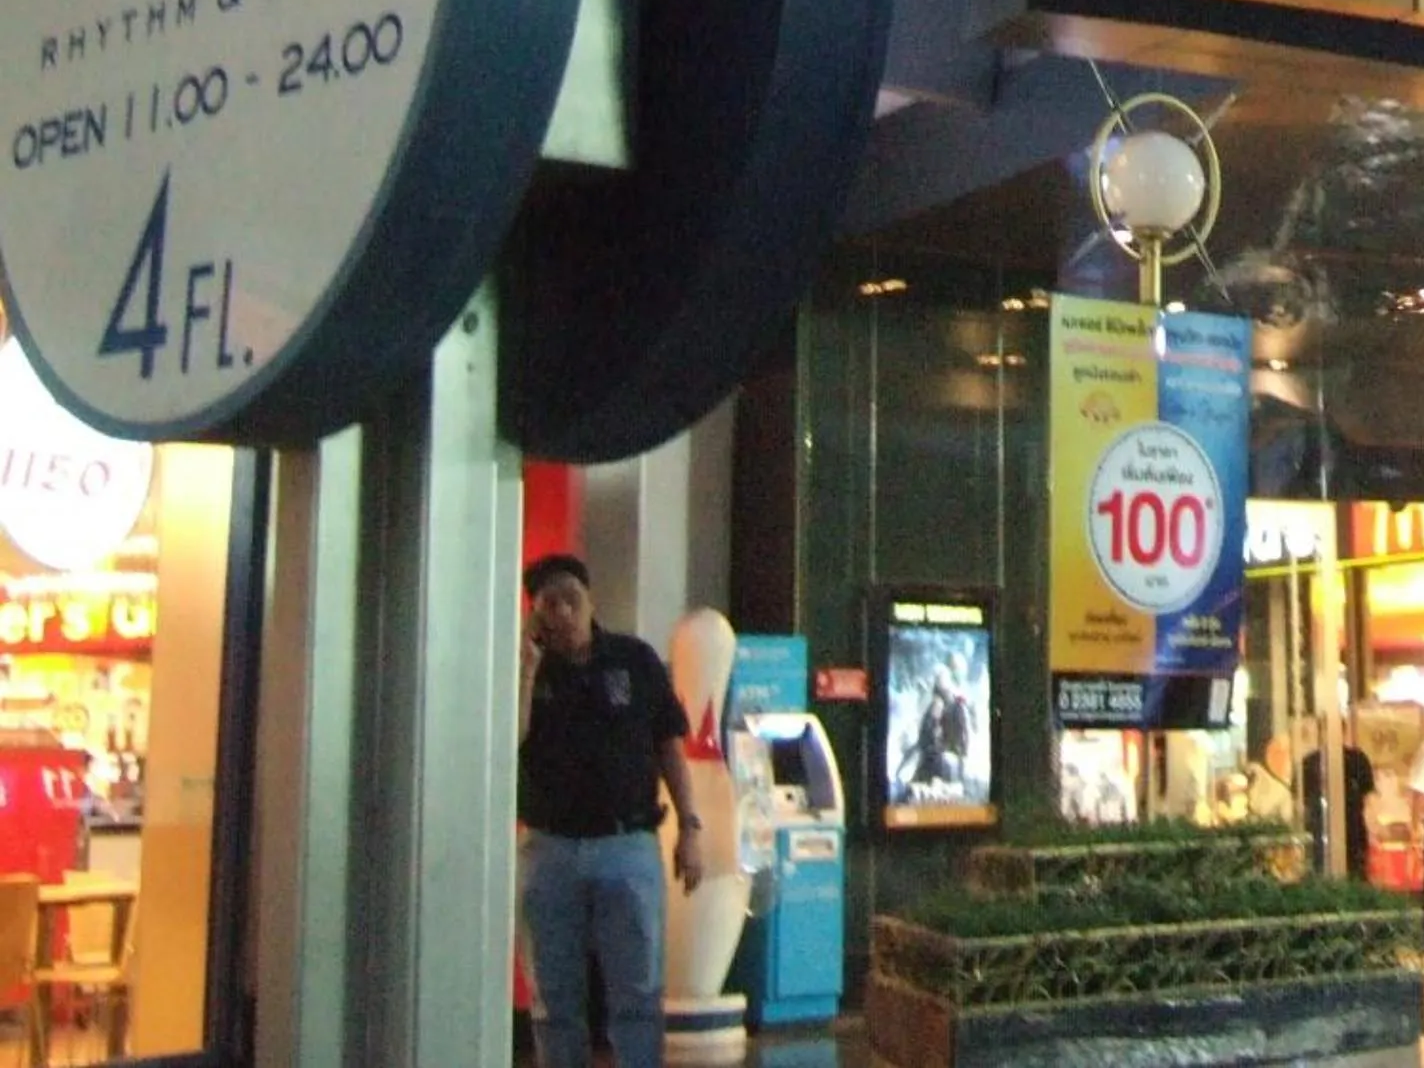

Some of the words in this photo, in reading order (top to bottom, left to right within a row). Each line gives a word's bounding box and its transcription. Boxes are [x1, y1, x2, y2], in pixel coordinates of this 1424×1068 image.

[12, 102, 108, 170] OPEN
[123, 65, 229, 140] 11.00
[277, 12, 404, 98] 24.00
[1097, 488, 1206, 570] 100
